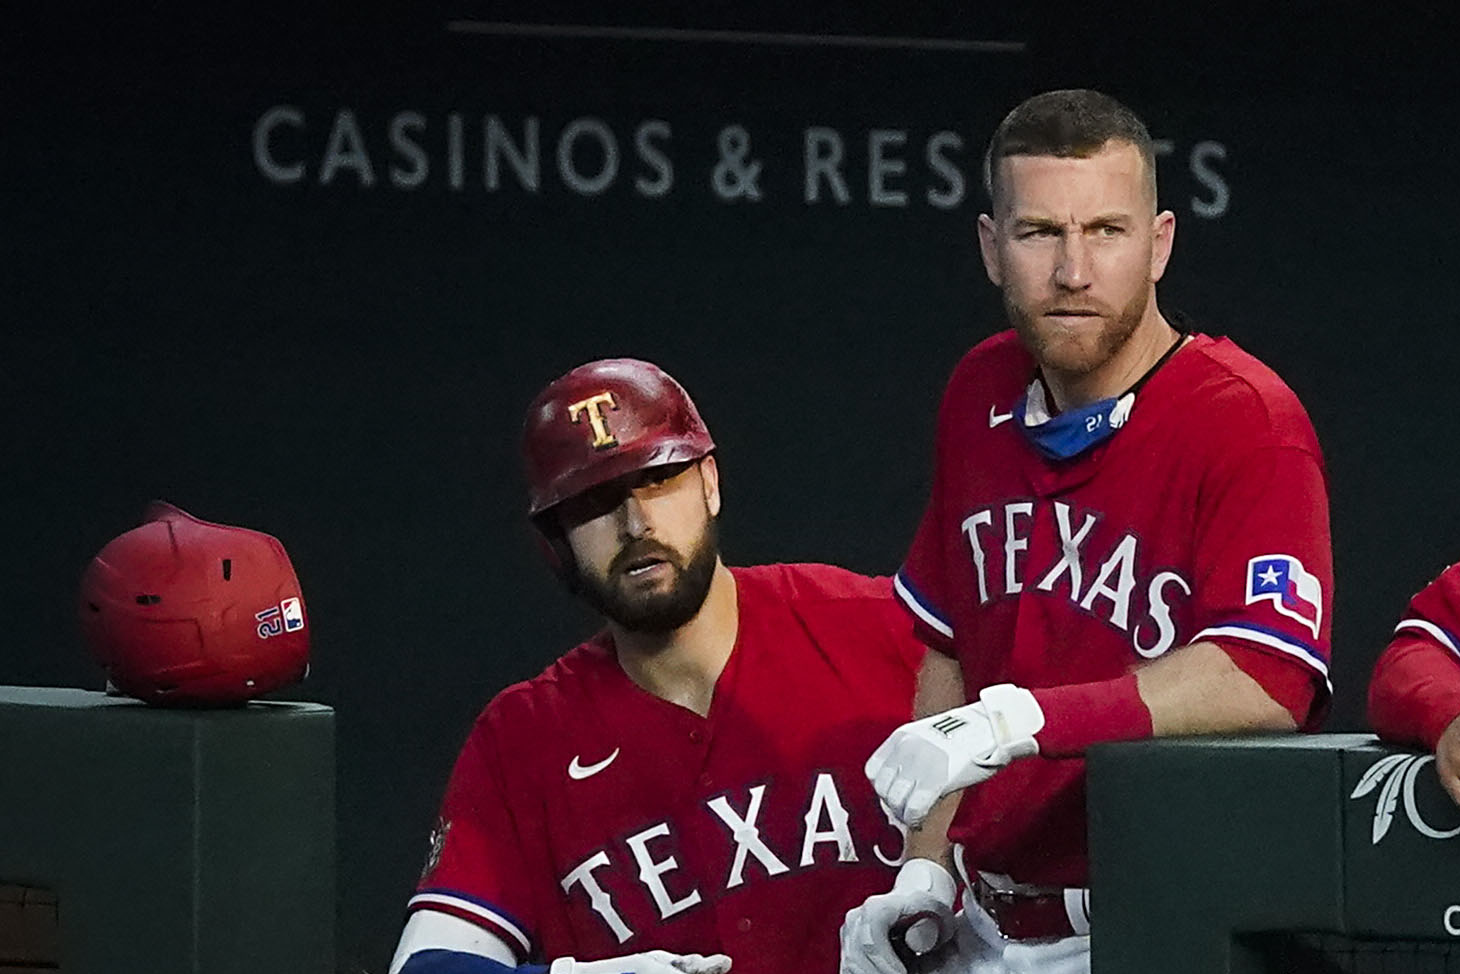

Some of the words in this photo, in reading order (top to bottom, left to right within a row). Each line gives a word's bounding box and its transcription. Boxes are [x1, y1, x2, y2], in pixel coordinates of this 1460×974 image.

[254, 108, 674, 197] CASINOS
[712, 125, 763, 200] &
[803, 126, 1231, 217] RESS
[567, 391, 620, 448] T
[961, 501, 1191, 658] TEXAS
[254, 606, 283, 640] 21
